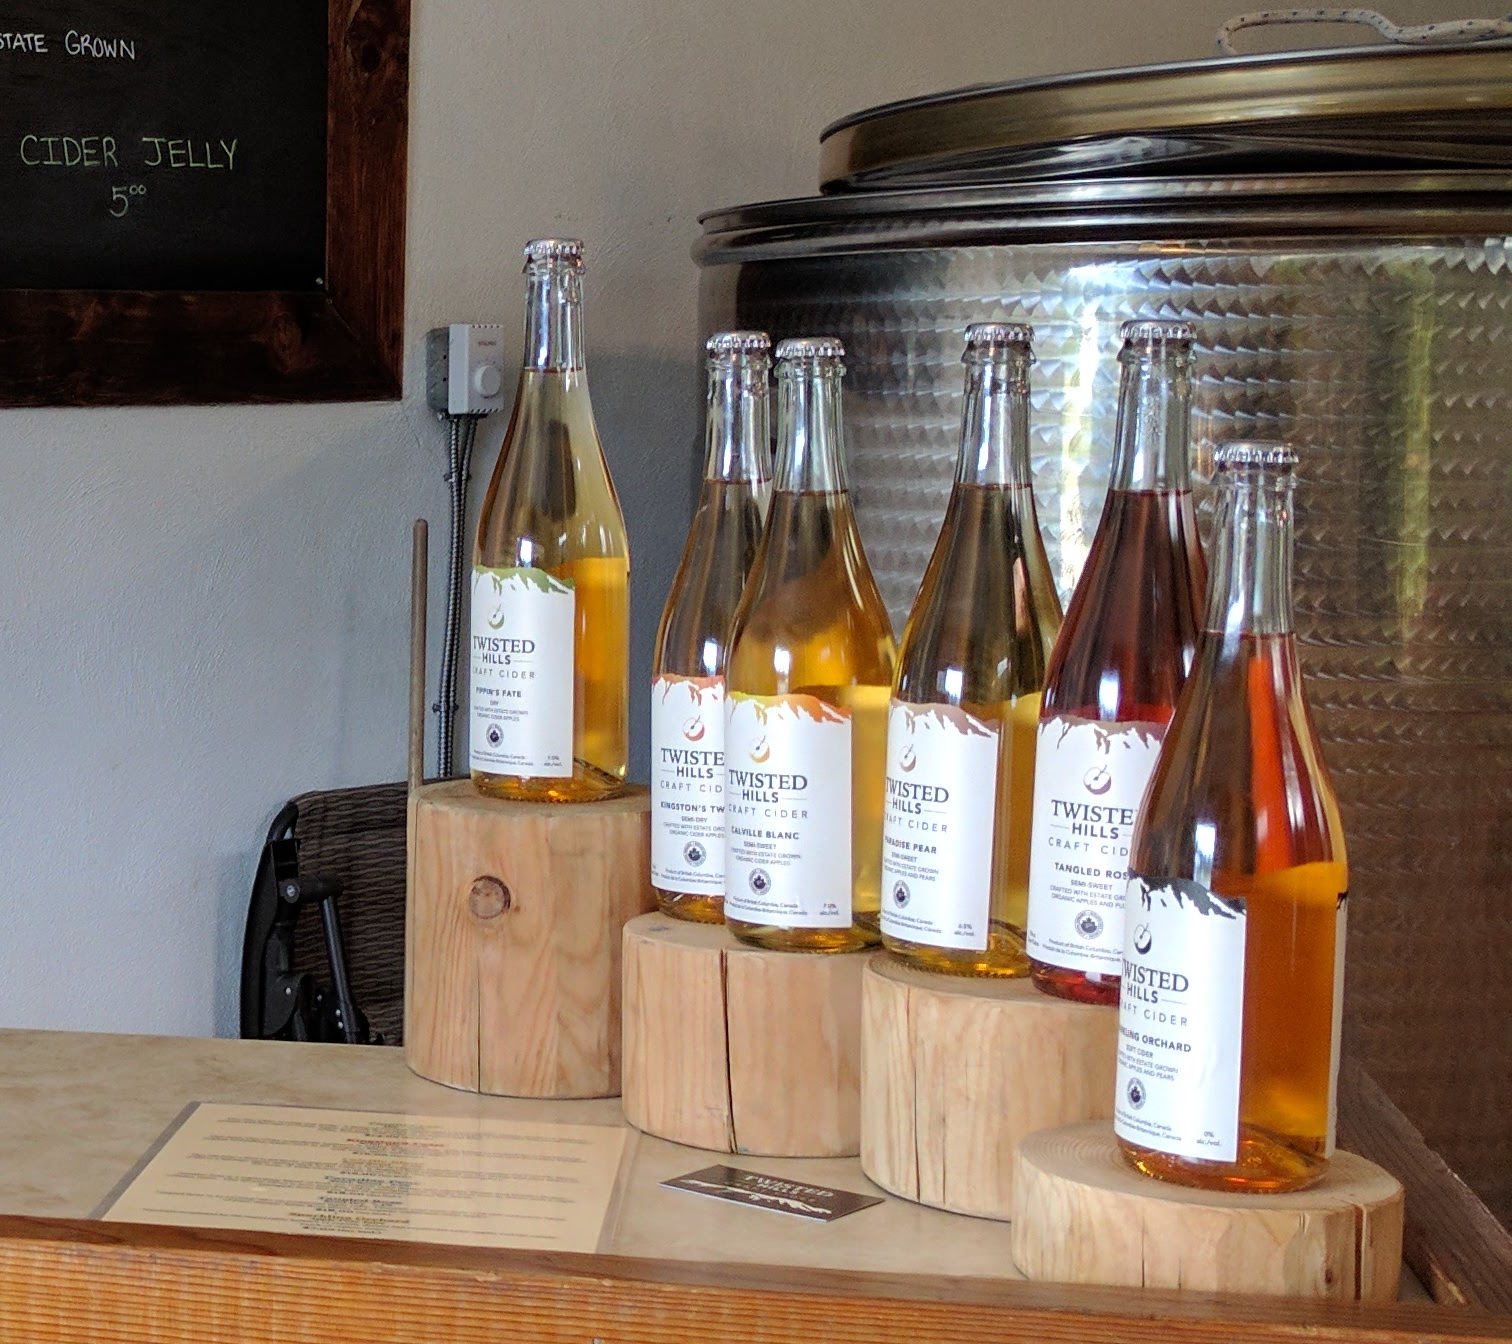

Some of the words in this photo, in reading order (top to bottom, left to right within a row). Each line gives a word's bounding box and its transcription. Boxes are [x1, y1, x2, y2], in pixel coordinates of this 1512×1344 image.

[64, 30, 137, 61] GROWN
[19, 134, 119, 168] CIDER
[140, 135, 239, 171] JELLY
[473, 635, 535, 654] TWISTED
[482, 653, 511, 665] HILLS
[498, 670, 535, 680] CIDER
[502, 690, 522, 698] FATE
[660, 748, 725, 766] TWISTE
[676, 766, 714, 779] HILLS
[728, 769, 808, 791] TWISTED
[660, 780, 692, 791] CRAFT
[699, 784, 723, 794] CID
[885, 776, 950, 804] TWISTED
[742, 789, 779, 804] HILLS
[764, 808, 808, 819] CIDER
[892, 798, 922, 815] HILLS
[1051, 799, 1136, 826] TWISTE
[731, 825, 763, 838] CALVILLE
[765, 831, 800, 840] BLANC
[908, 819, 948, 833] CIDER
[1072, 822, 1119, 840] HILLS
[913, 843, 937, 854] PEAR
[1048, 836, 1090, 853] CRAFT
[1100, 845, 1129, 857] CID
[1054, 862, 1101, 877] TANGLED
[1105, 870, 1129, 880] ROS
[1126, 983, 1158, 1004] HILLS
[1143, 1009, 1188, 1027] CIDER
[1141, 1033, 1192, 1053] ORCHARD
